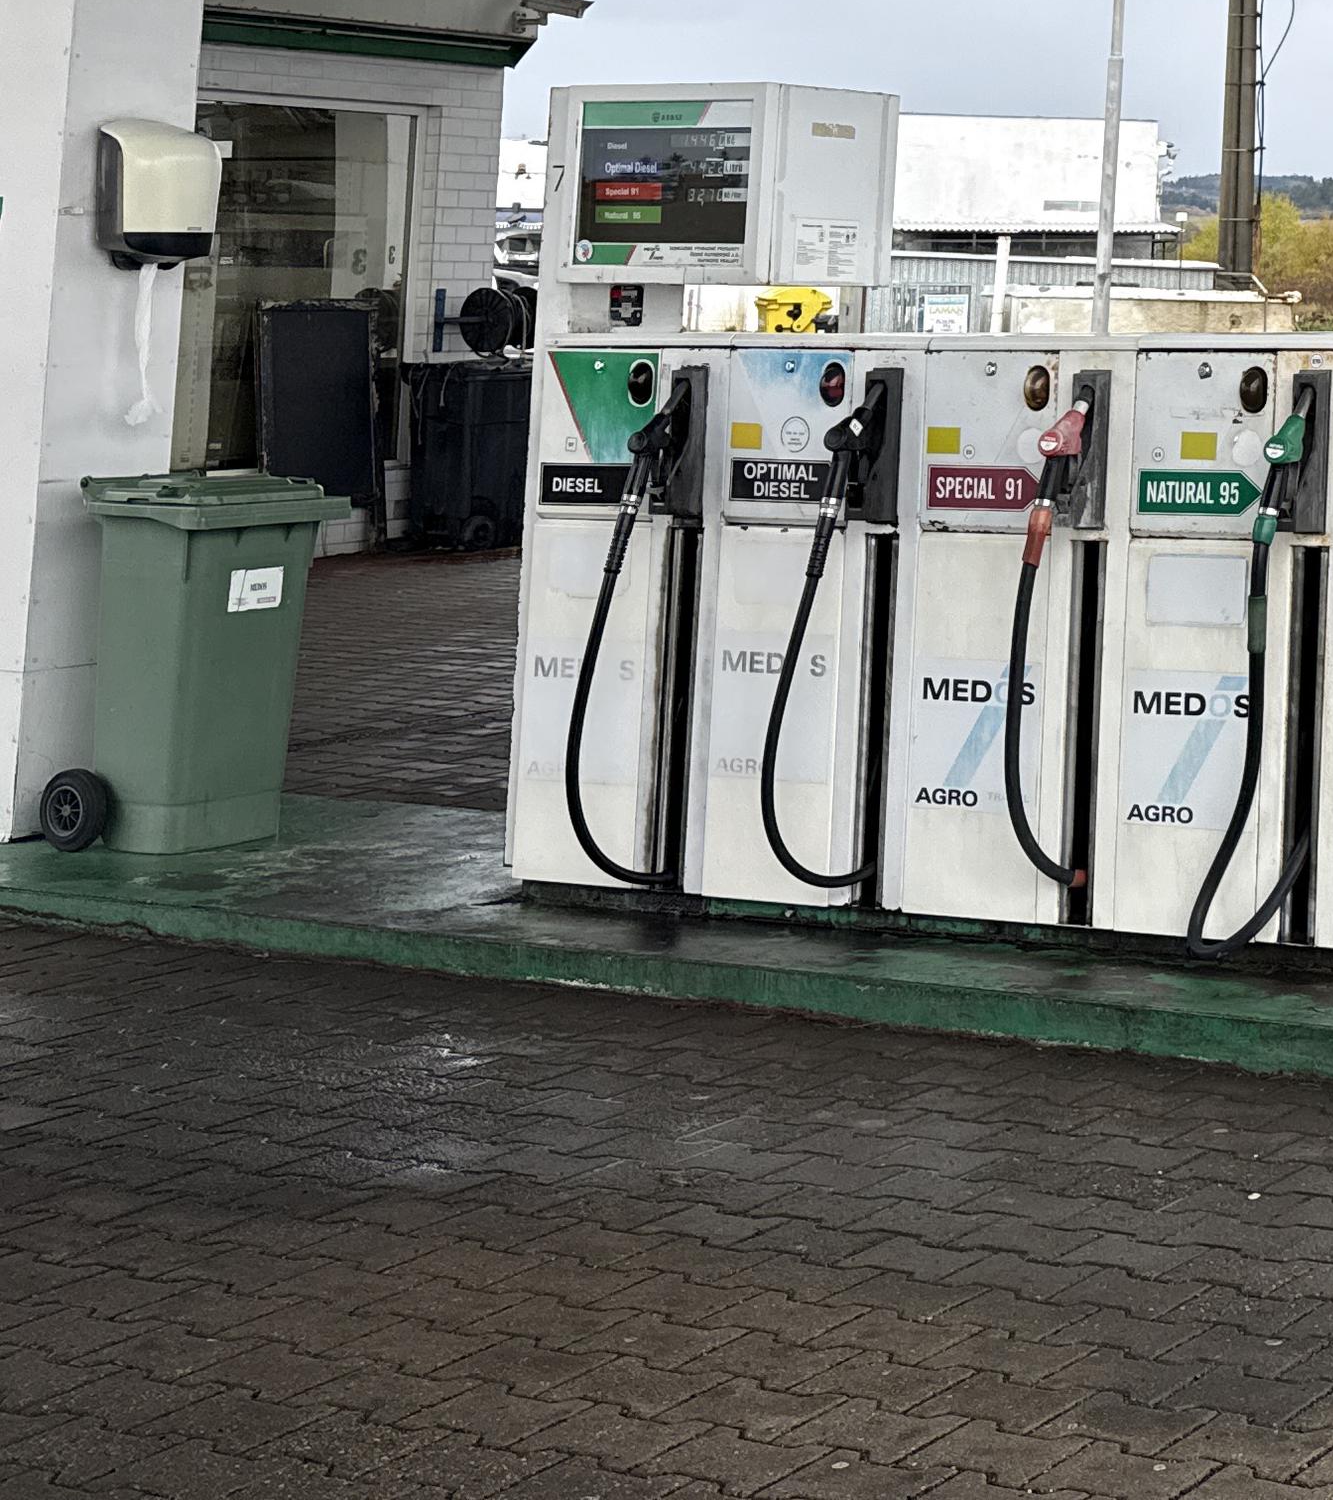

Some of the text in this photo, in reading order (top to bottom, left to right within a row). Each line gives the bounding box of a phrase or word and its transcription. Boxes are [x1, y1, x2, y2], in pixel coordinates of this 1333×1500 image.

[606, 142, 628, 150] Diesel
[604, 161, 658, 176] Optimal Diesel
[552, 165, 565, 192] 7
[605, 187, 629, 197] Special
[604, 211, 629, 220] Natural
[743, 462, 819, 482] OPTIMAL
[552, 477, 603, 494] DIESEL
[753, 481, 810, 499] DIESEL
[935, 475, 1023, 500] SPECIAL 91
[1146, 480, 1240, 505] NATURAL 95
[1133, 690, 1250, 718] MEDOS
[716, 756, 763, 775] AGR
[915, 787, 978, 807] AGRO
[1127, 803, 1194, 824] AGRO
